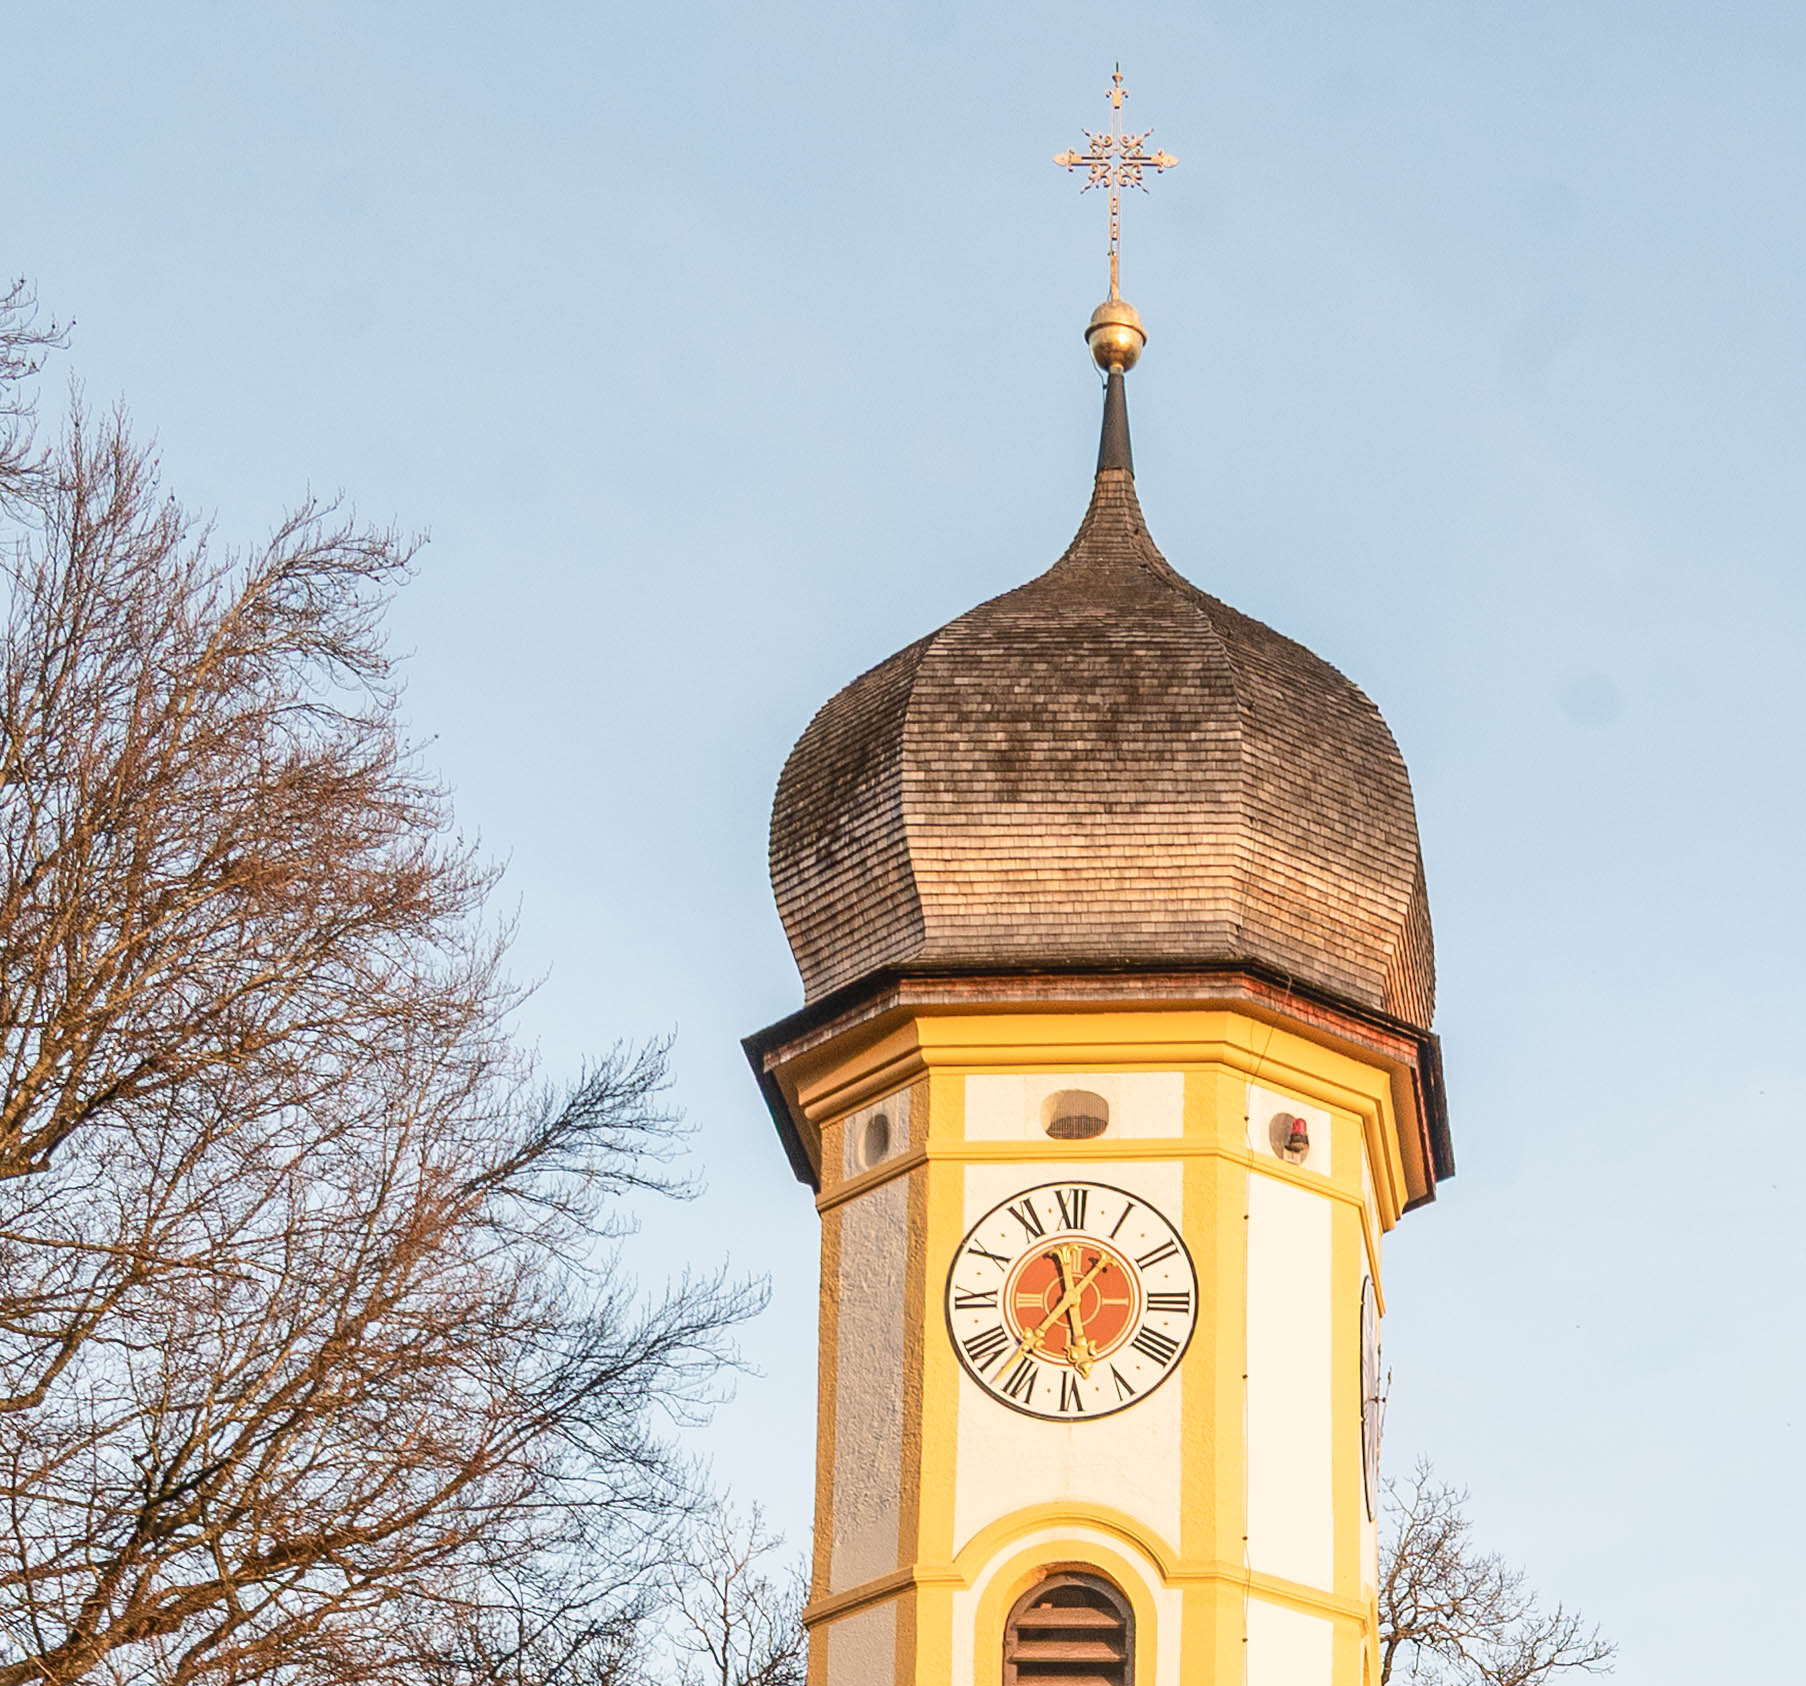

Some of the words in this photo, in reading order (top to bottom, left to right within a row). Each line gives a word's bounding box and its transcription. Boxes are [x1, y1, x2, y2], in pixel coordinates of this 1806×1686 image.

[1008, 1198, 1046, 1244] XI
[1054, 1188, 1089, 1232] XII
[1109, 1201, 1136, 1240] I
[967, 1238, 1011, 1272] X
[1135, 1239, 1180, 1272] II
[954, 1286, 998, 1311] IX
[1146, 1290, 1190, 1314] III
[962, 1324, 1008, 1373] VIII
[1130, 1325, 1180, 1368] IIII
[1003, 1356, 1040, 1404] VII
[1058, 1370, 1085, 1411] VI
[1109, 1363, 1136, 1401] V
